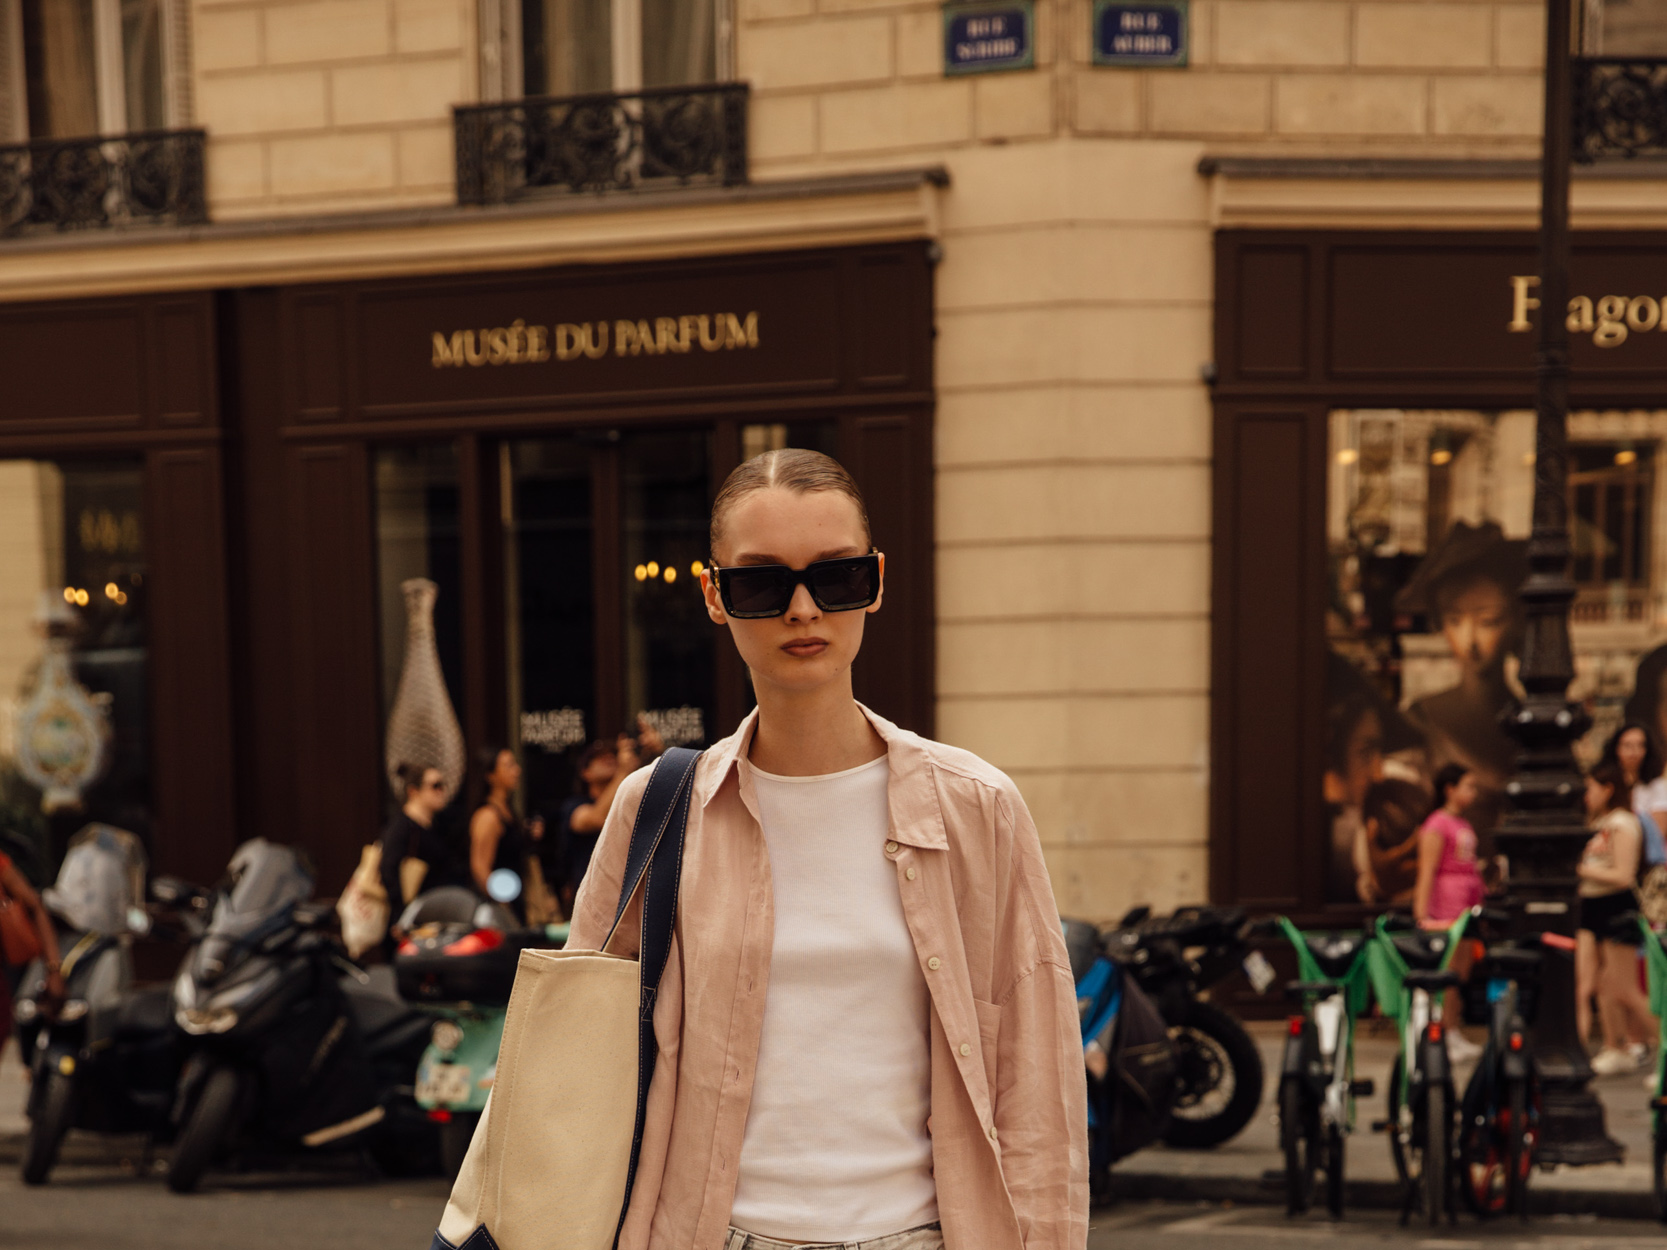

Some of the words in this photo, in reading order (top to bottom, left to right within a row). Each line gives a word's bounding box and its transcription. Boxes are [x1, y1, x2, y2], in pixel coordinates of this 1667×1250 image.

[432, 317, 550, 368] MUSÉE
[555, 320, 609, 361] DU
[614, 310, 760, 357] PARFUM
[1506, 275, 1667, 349] Fago
